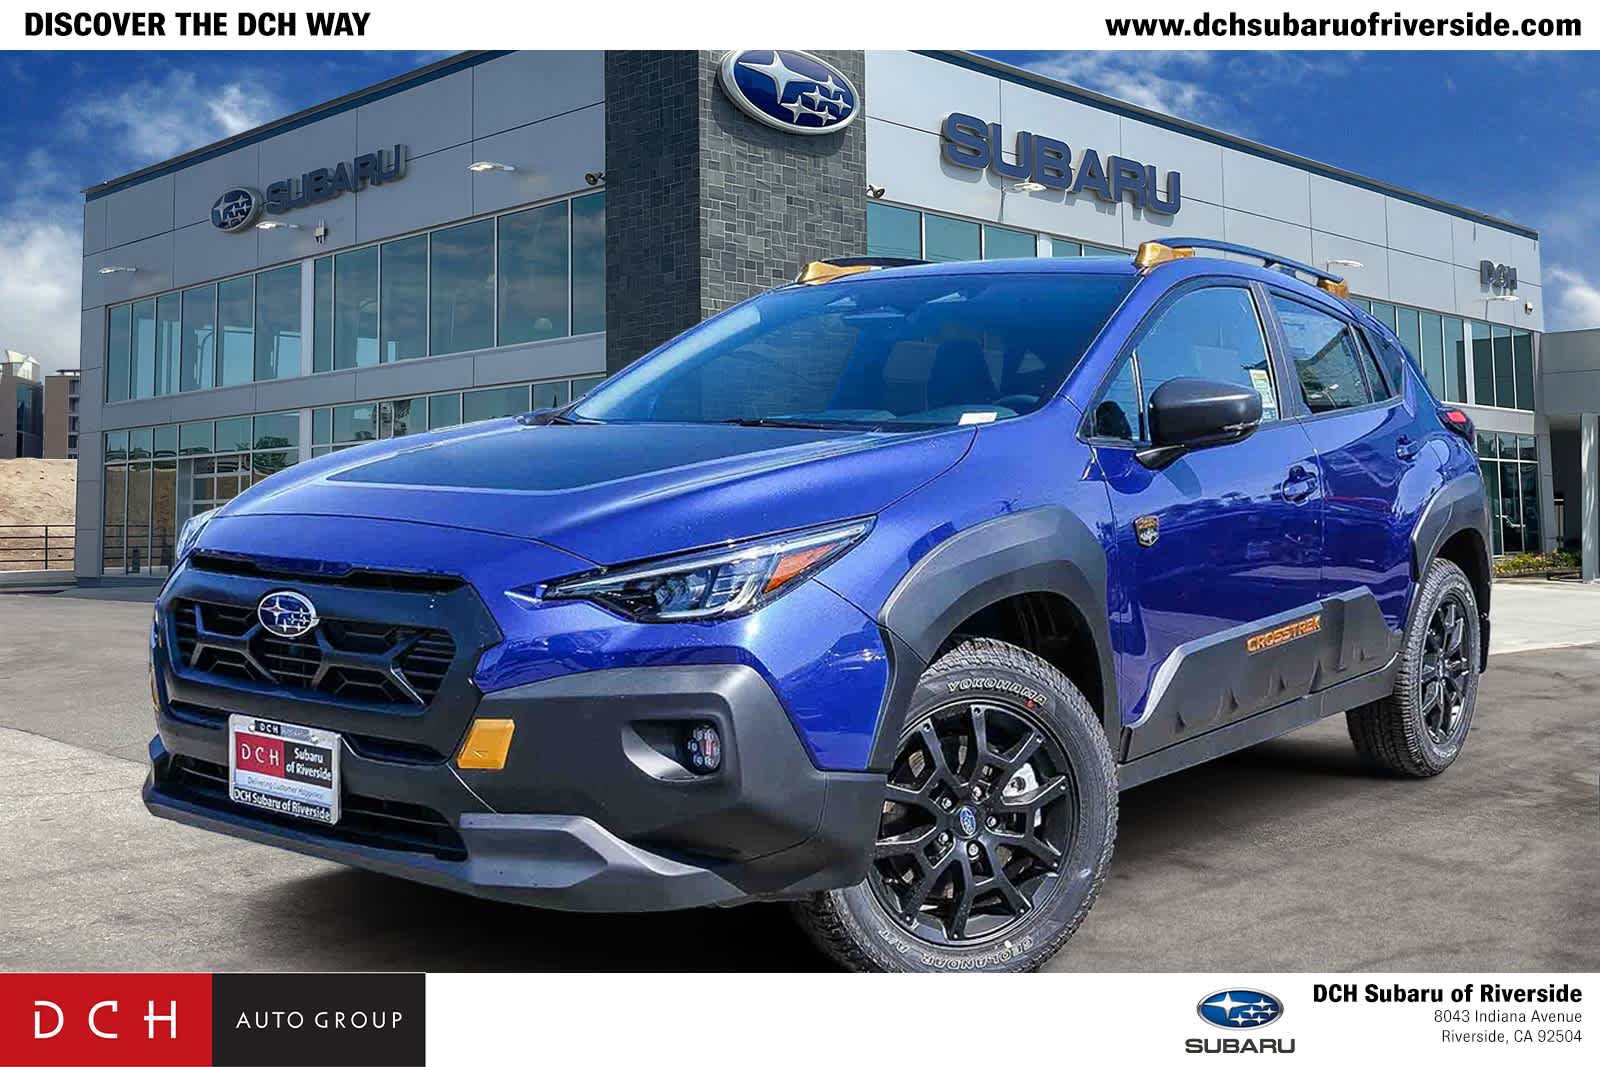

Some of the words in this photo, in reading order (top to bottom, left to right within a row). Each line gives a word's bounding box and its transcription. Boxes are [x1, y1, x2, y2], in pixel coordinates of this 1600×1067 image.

[942, 112, 1181, 215] SUBARU
[265, 144, 407, 215] SUBARU
[1246, 614, 1322, 653] CROSSTREK
[947, 677, 1047, 705] YOKOHAMA
[260, 723, 279, 733] DCH
[241, 743, 279, 766] DCH
[294, 747, 324, 763] Subaru
[285, 761, 296, 774] of
[296, 762, 332, 781] Riverside
[234, 789, 252, 801] DCH
[252, 792, 281, 809] Subaru
[281, 800, 291, 811] of
[291, 801, 331, 820] Riverside
